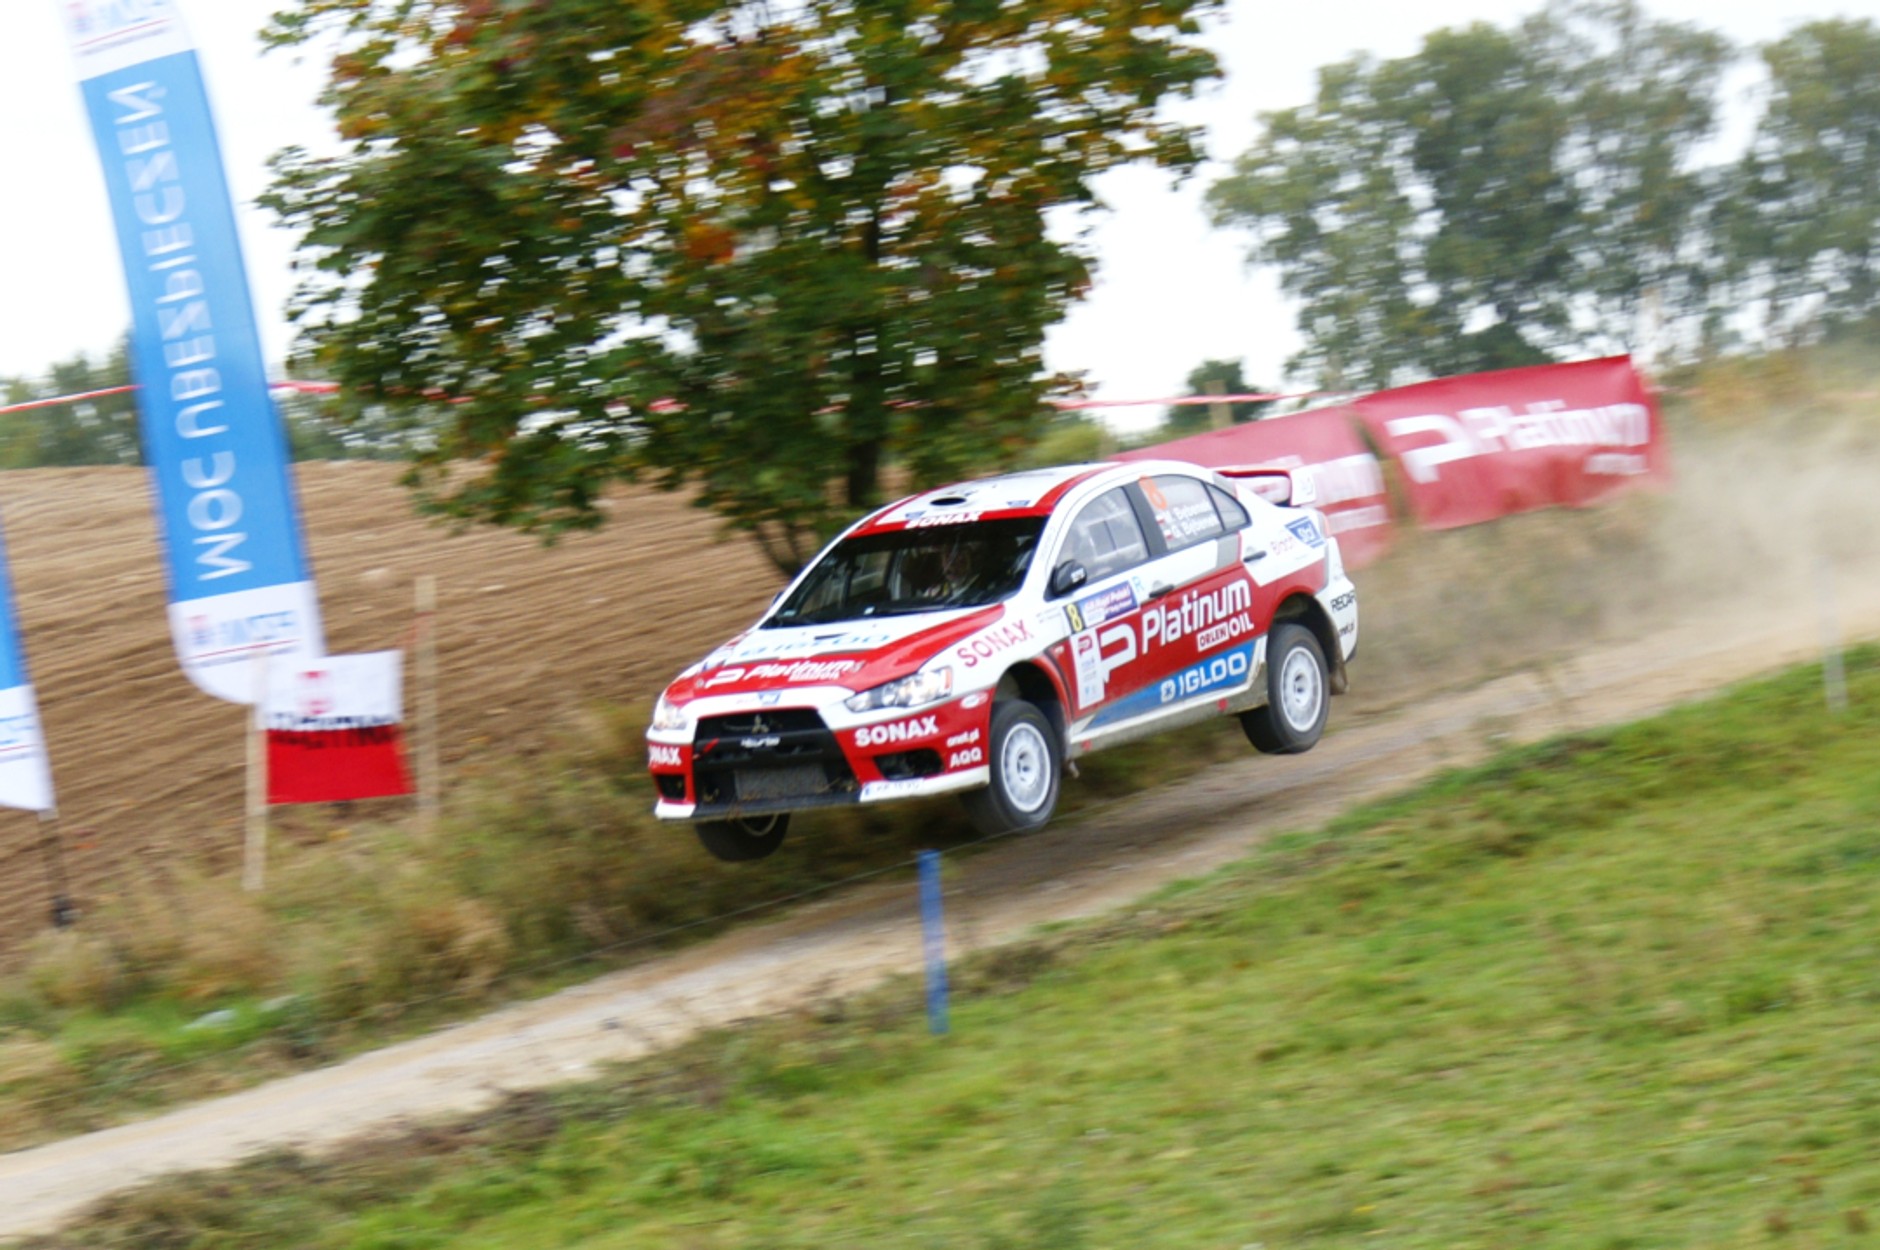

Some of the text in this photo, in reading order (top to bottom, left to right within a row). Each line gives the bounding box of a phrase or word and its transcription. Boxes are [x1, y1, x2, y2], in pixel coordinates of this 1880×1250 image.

[1457, 399, 1650, 452] Platinum
[905, 511, 981, 529] SONAX
[1067, 603, 1083, 632] 8
[1142, 579, 1251, 655] Platinum
[1199, 612, 1254, 650] ORLEN OIL
[957, 619, 1034, 667] SONAX
[743, 660, 855, 681] Platinum
[1179, 651, 1248, 697] IGLOO
[855, 715, 939, 748] SONAX
[949, 746, 983, 769] AQQ
